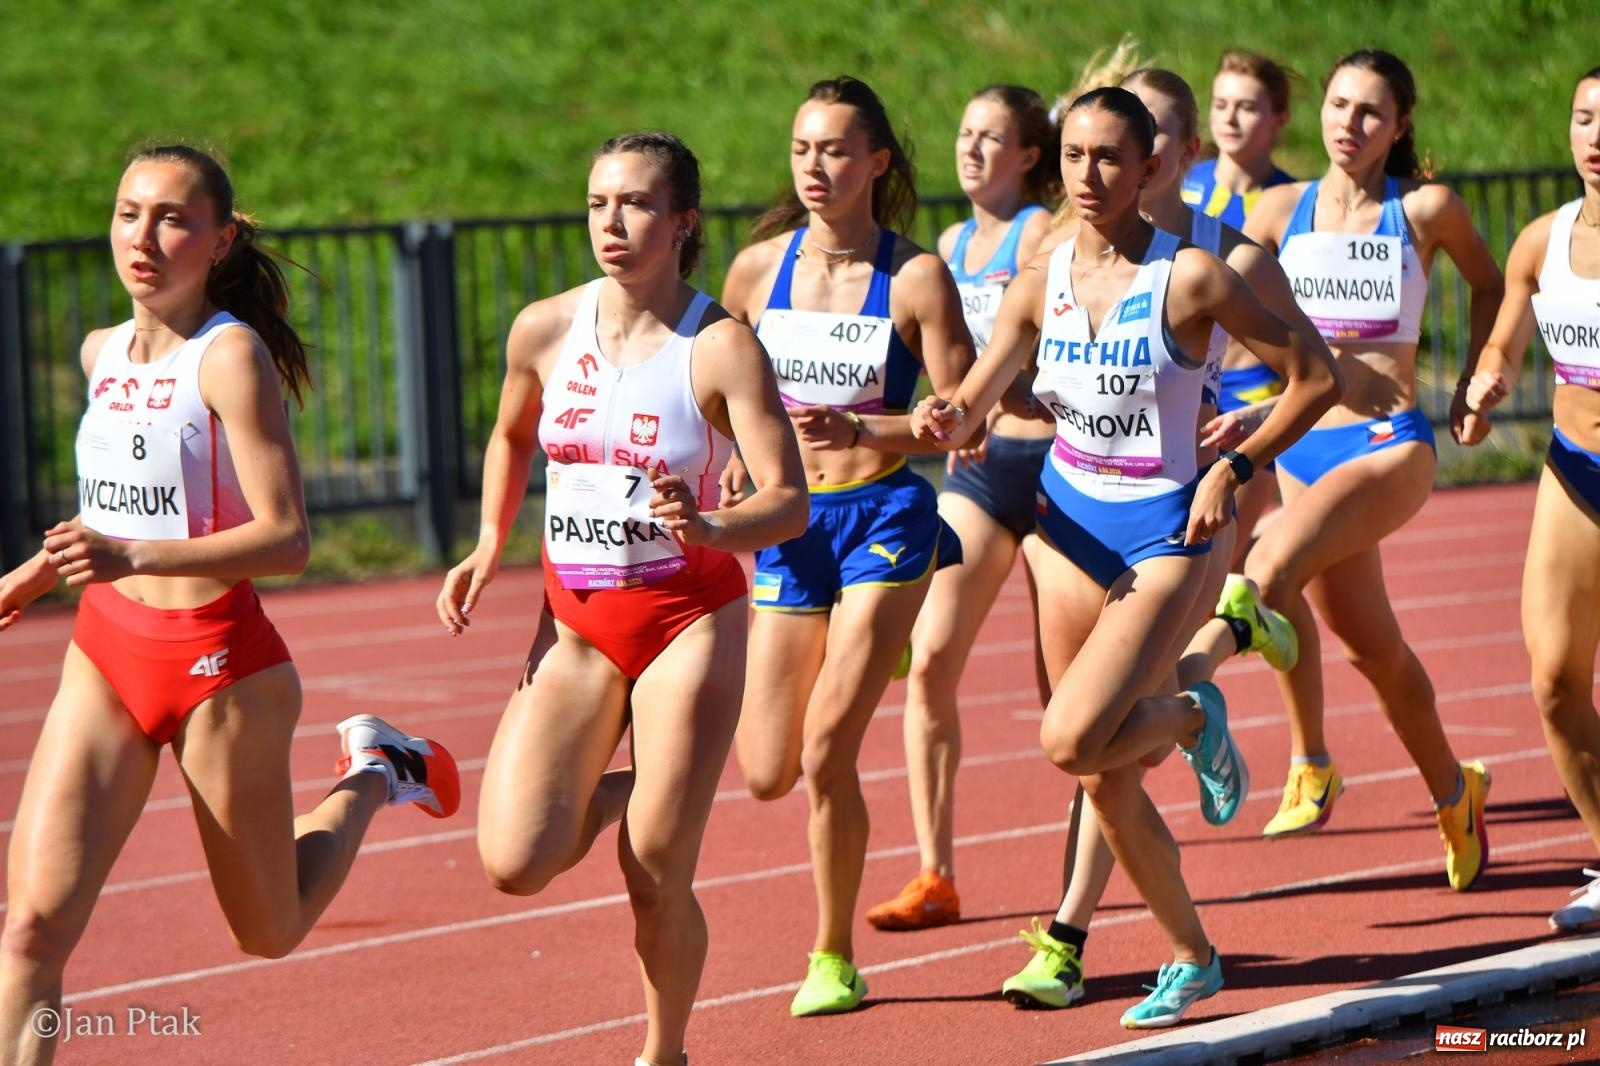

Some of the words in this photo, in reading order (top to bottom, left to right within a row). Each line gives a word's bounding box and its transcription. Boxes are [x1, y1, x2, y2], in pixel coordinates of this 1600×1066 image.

[1348, 241, 1389, 261] 108
[1293, 275, 1395, 302] ADVANAOVÁ
[964, 294, 991, 315] 507
[830, 322, 877, 343] 407
[770, 357, 879, 388] UBANSKA
[1096, 374, 1140, 395] 107
[567, 381, 597, 396] ORLEN
[109, 401, 135, 412] ORLEN
[555, 408, 595, 429] 4F
[1050, 401, 1153, 438] CECHOVÁ
[132, 434, 146, 460] 8
[79, 475, 180, 516] WCZARUK
[624, 474, 641, 499] 7
[550, 515, 670, 550] PAJĘCKA
[188, 647, 229, 677] 4F
